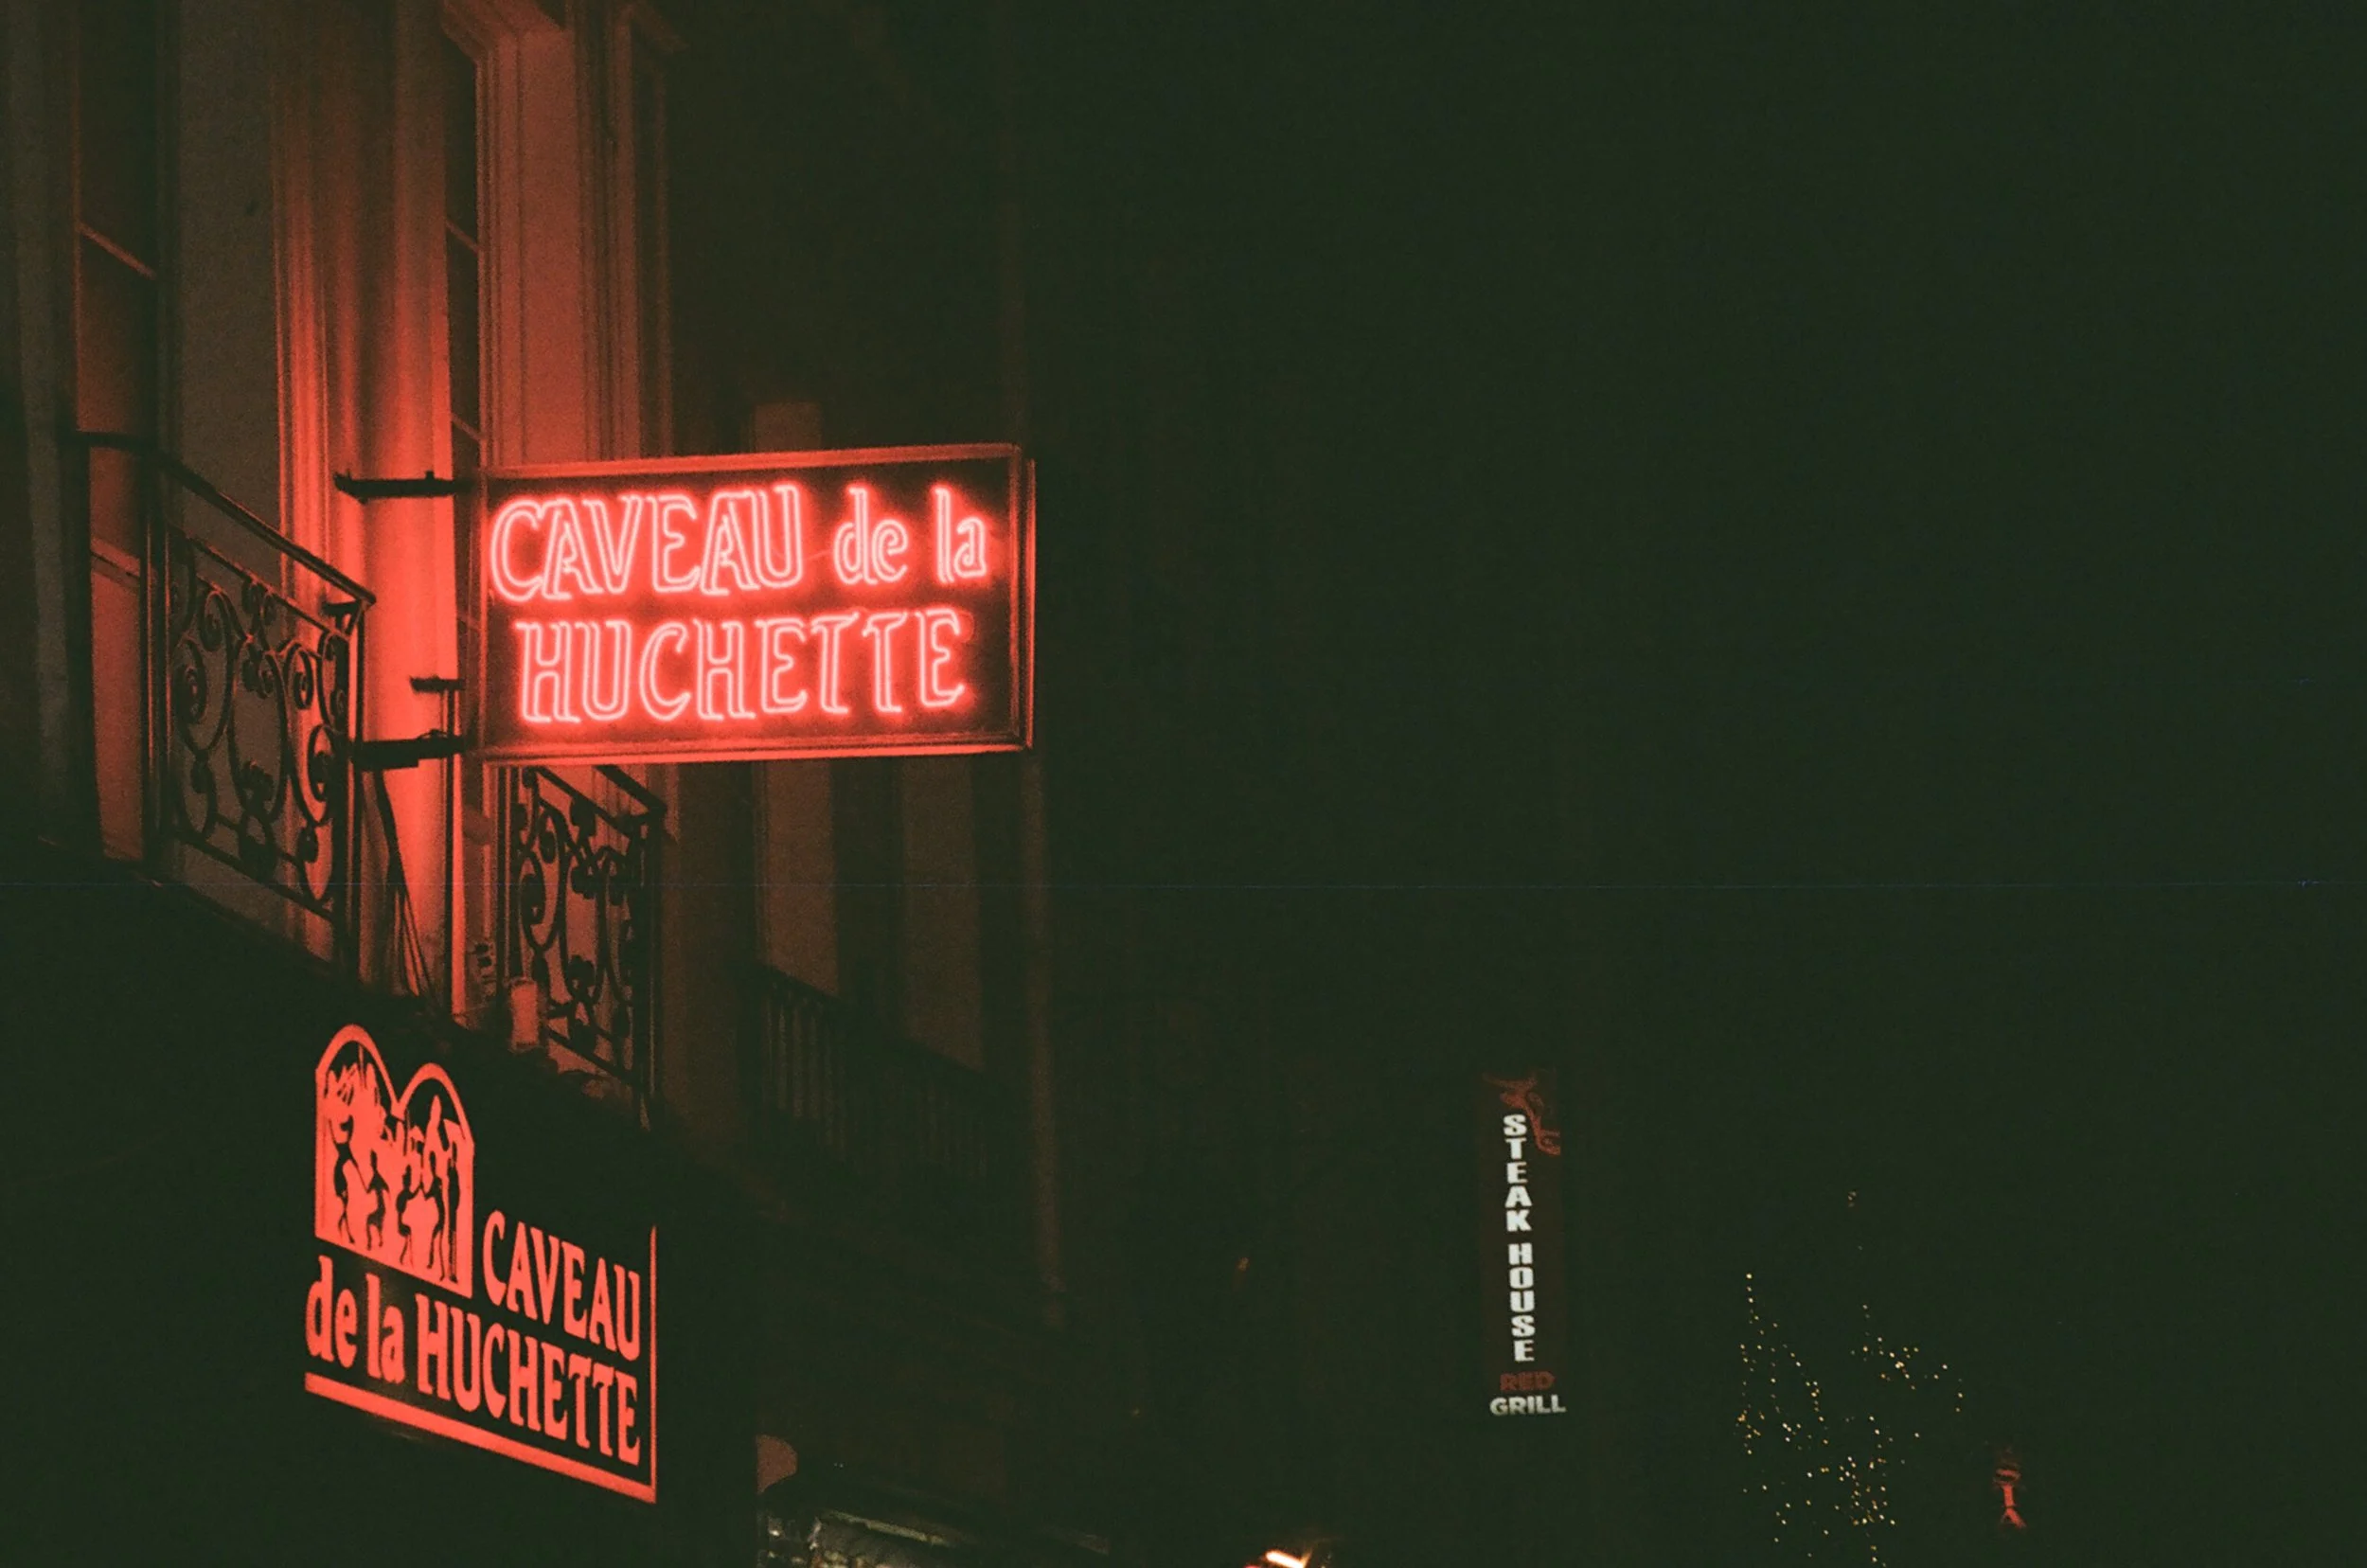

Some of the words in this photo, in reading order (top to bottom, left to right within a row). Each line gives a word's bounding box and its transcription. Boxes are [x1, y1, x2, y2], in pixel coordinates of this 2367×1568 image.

[489, 484, 805, 602] CAVEAU
[833, 486, 909, 585] de
[934, 486, 988, 583] la
[512, 608, 966, 722] HUCHETTE
[1503, 1114, 1533, 1232] STEAK
[483, 1210, 641, 1361] CAVEAU
[1508, 1242, 1536, 1362] HOUSE
[305, 1255, 358, 1369] de
[365, 1273, 405, 1383] la
[415, 1293, 641, 1466] HUCHETTE
[1489, 1394, 1567, 1417] GRILL
[1500, 1371, 1556, 1391] RED
